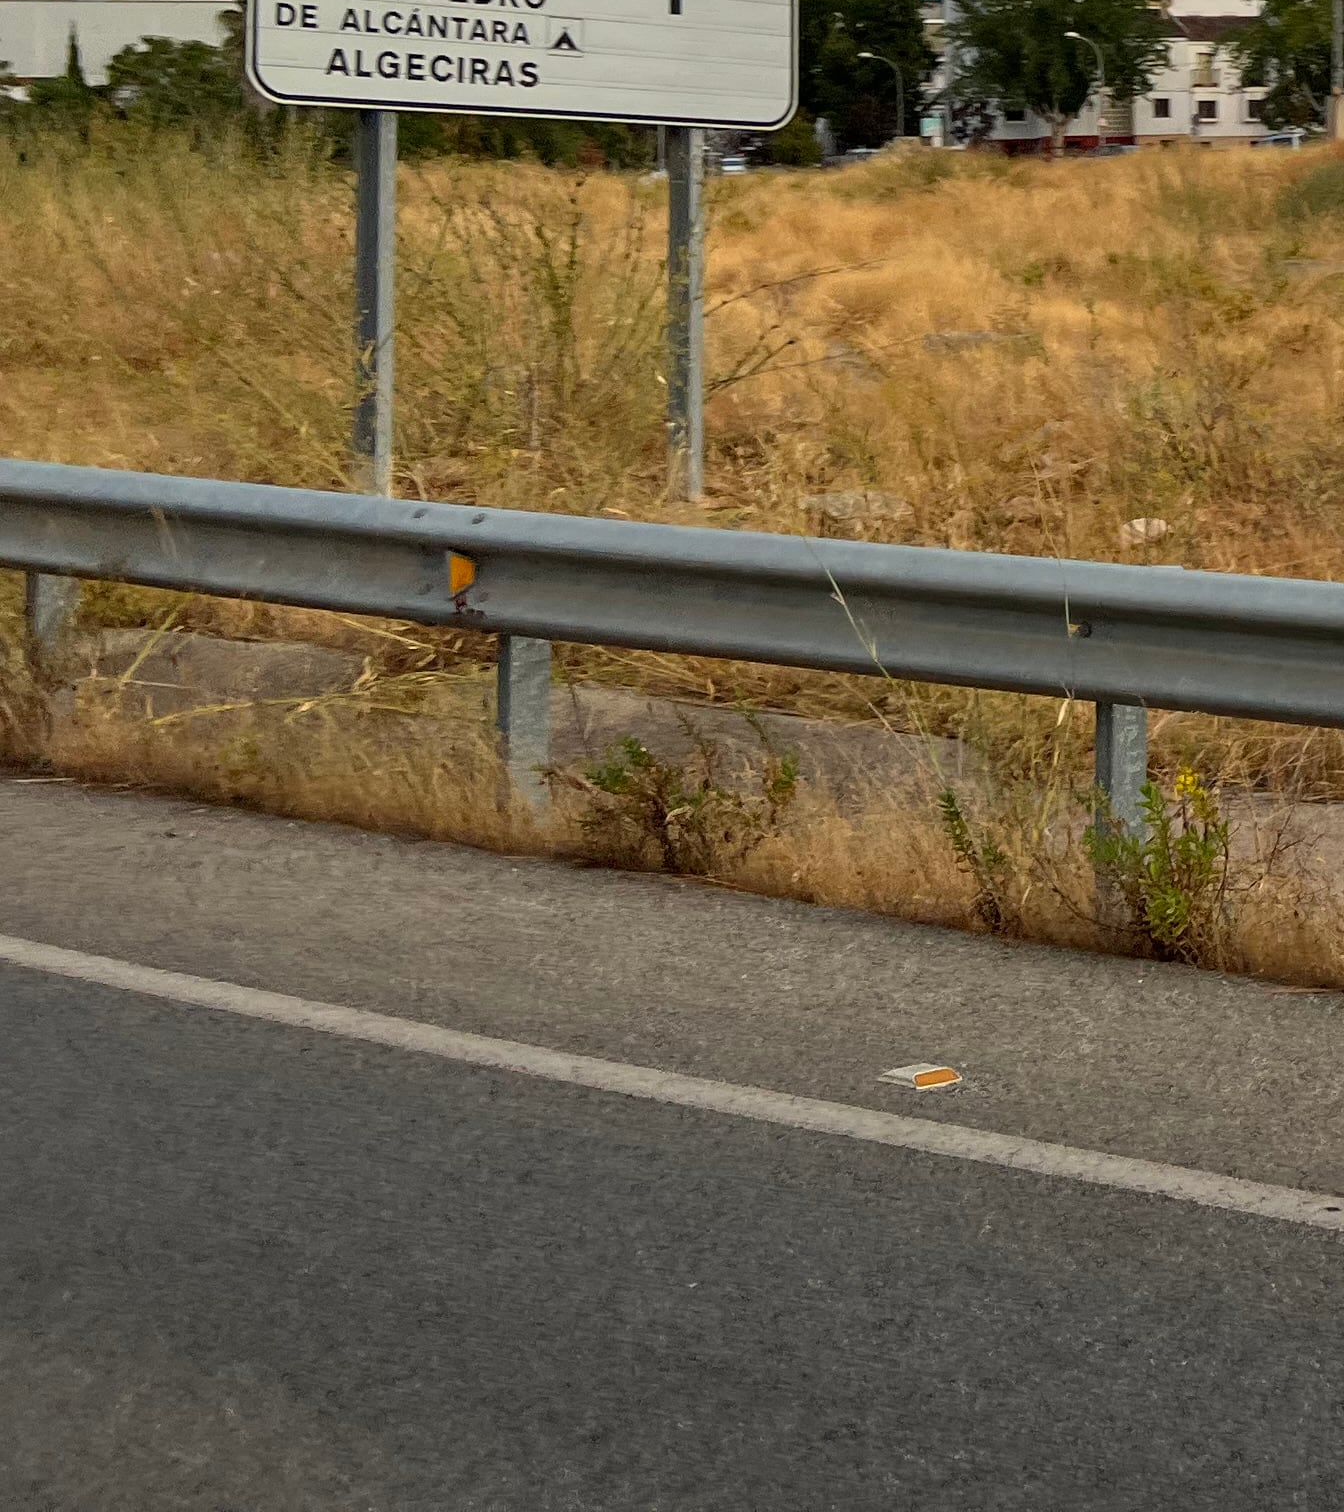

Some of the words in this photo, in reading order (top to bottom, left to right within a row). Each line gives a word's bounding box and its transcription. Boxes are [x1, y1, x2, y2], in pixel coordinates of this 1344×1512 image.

[275, 2, 319, 29] DE
[339, 7, 531, 45] ALCÁNTARA
[325, 48, 541, 88] ALGECIRAS
